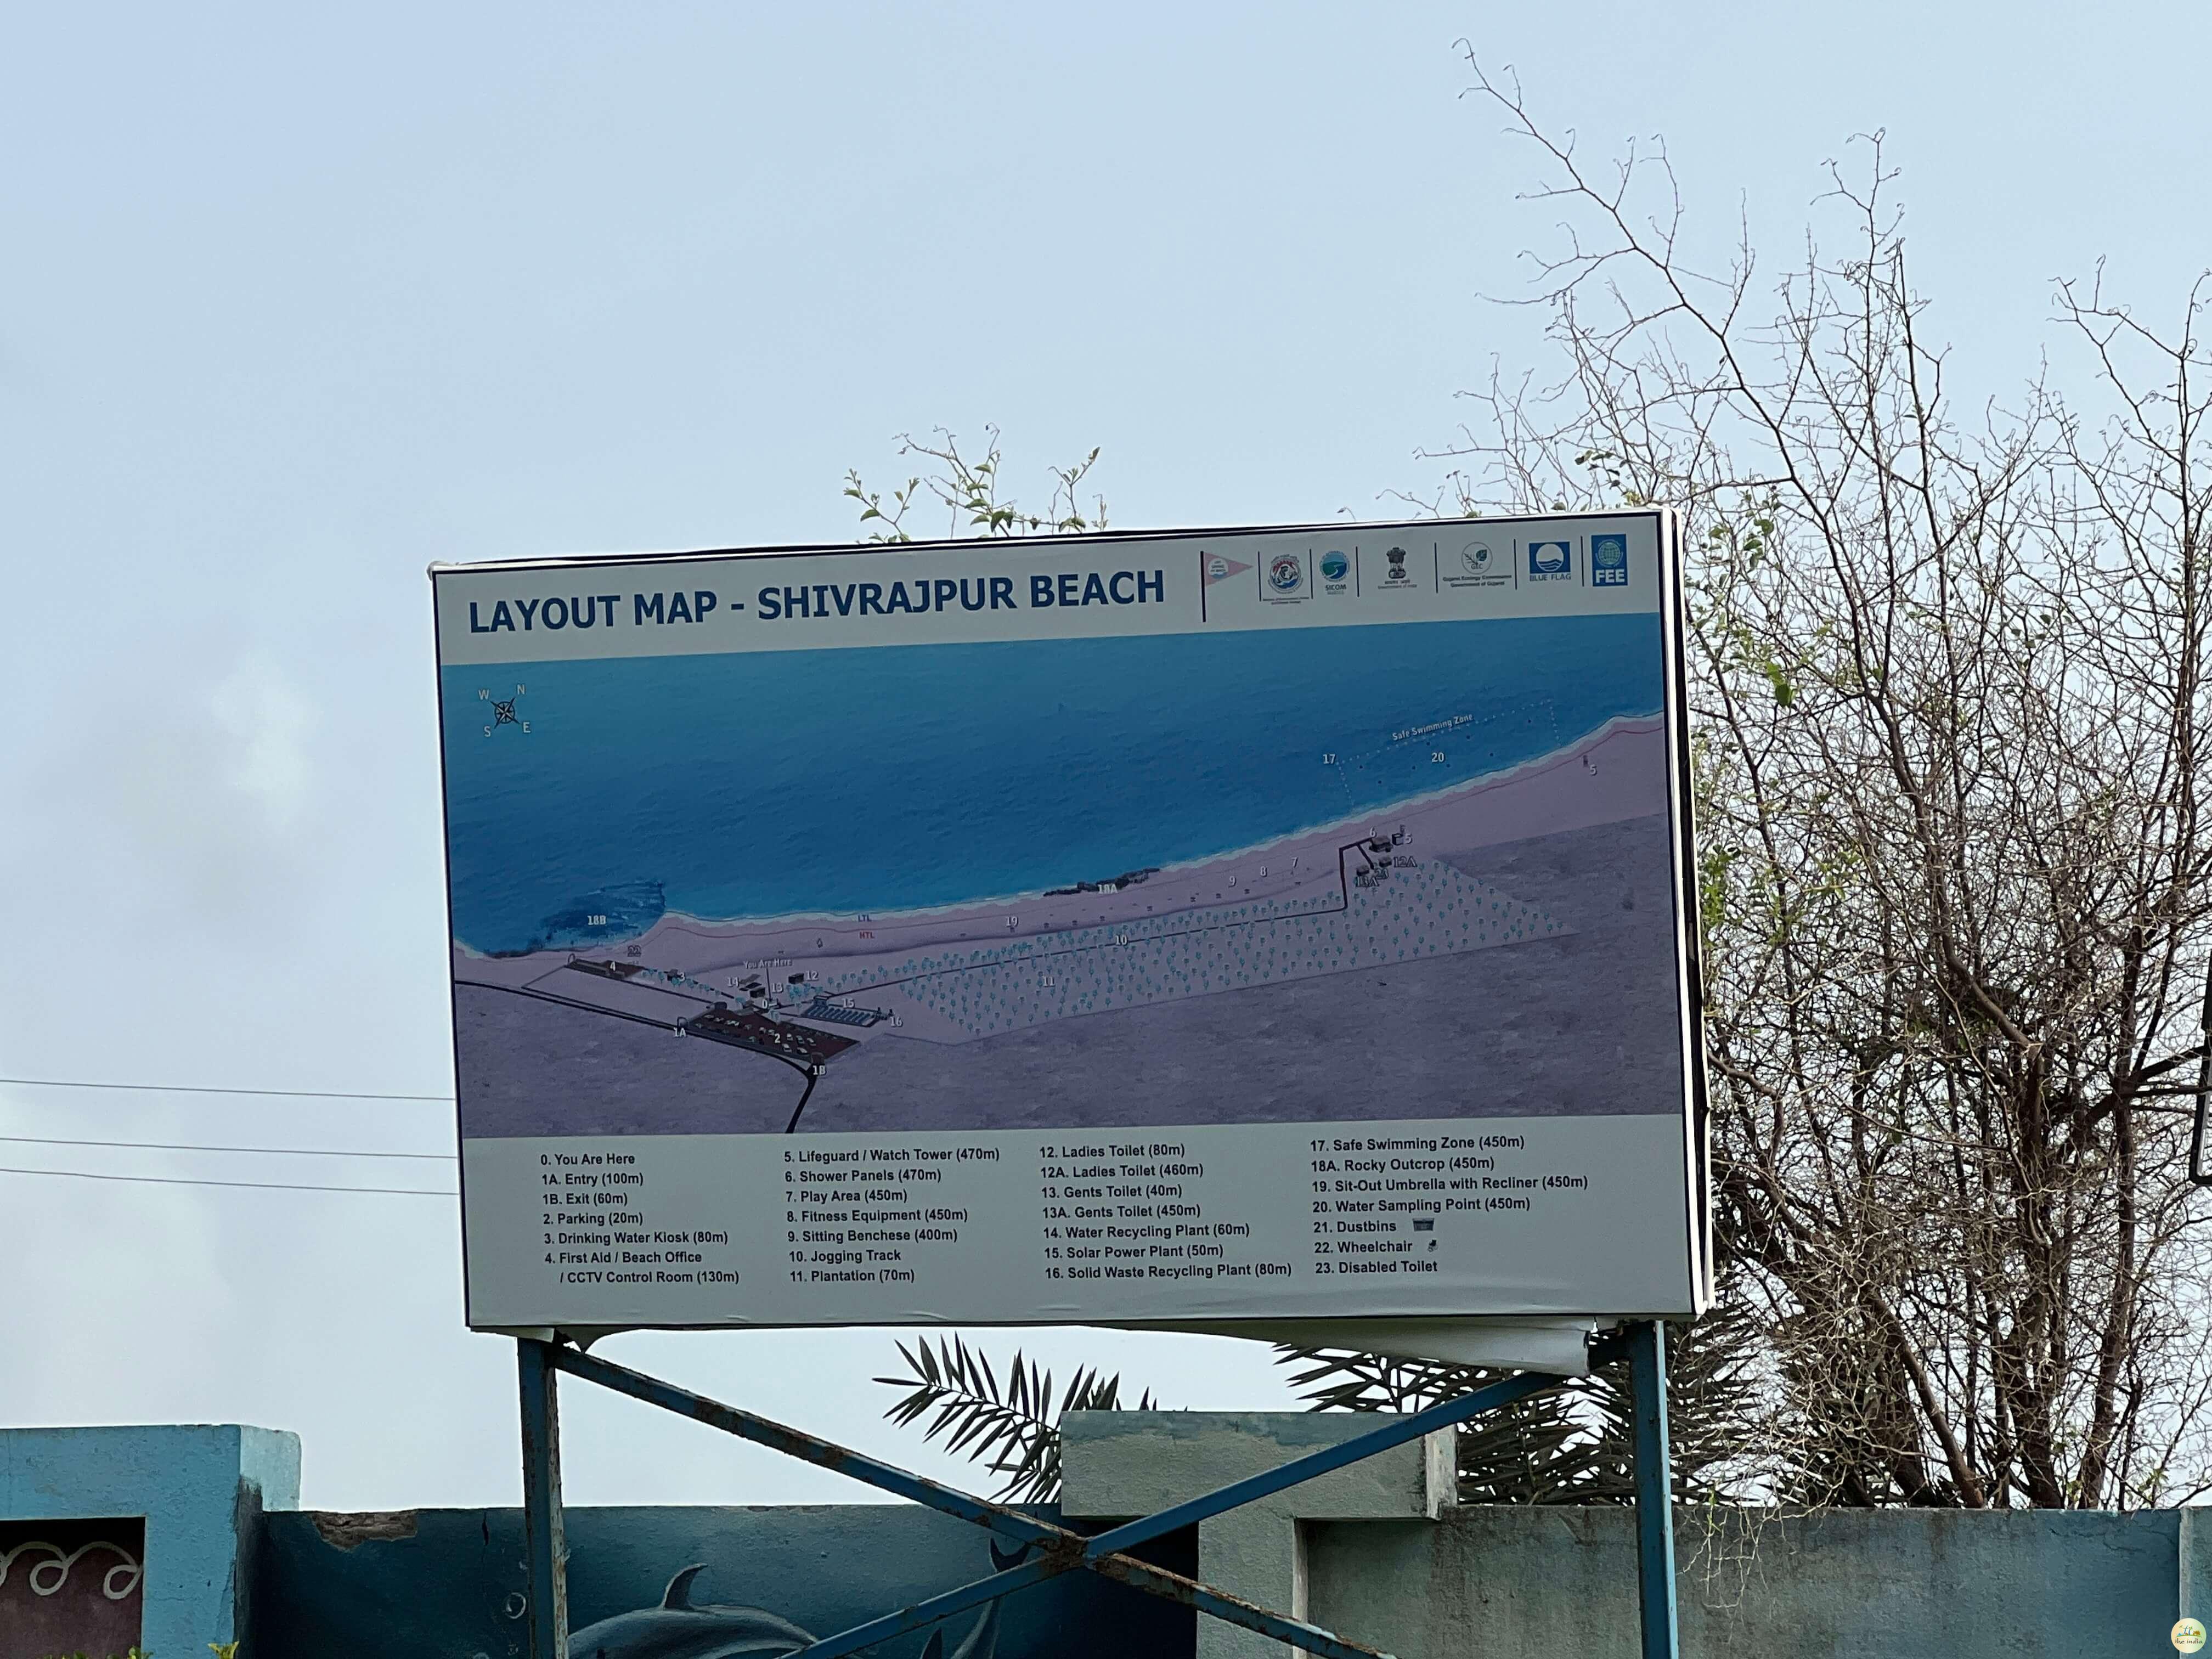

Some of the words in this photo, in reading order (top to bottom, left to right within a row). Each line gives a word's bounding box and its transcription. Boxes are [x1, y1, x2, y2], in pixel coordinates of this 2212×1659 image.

[1595, 569, 1625, 583] FEE
[469, 595, 621, 634] LAYOUT
[634, 590, 718, 625] MAP
[731, 603, 744, 612] -
[757, 577, 1016, 620] SHIVRAJPUR
[1030, 569, 1165, 608] BEACH
[478, 689, 489, 700] W
[517, 684, 525, 695] N
[484, 726, 491, 737] S
[523, 722, 531, 733] E
[1392, 729, 1410, 741] Safe
[1412, 720, 1452, 736] Swimming
[1323, 754, 1336, 764] 17
[1431, 752, 1444, 763] 20
[1589, 765, 1597, 776] 5
[1006, 917, 1019, 927] 19
[1115, 935, 1128, 945] 10
[743, 961, 757, 969] You
[759, 960, 772, 968] Are
[774, 958, 792, 967] Here
[727, 977, 740, 987] 14
[806, 971, 819, 980] 12
[1043, 977, 1055, 986] 11
[771, 984, 783, 992] 13
[843, 998, 855, 1008] 15
[890, 1017, 903, 1026] 16
[673, 1028, 687, 1037] 1A
[812, 1065, 826, 1075] 1B
[1311, 1140, 1329, 1151] 17.
[1334, 1139, 1362, 1150] Safe
[1368, 1138, 1436, 1151] Swimming
[1441, 1137, 1474, 1148] Zone
[1480, 1136, 1524, 1150] (450m)
[785, 1152, 794, 1162] 5.
[799, 1150, 859, 1164] Lifeguard
[863, 1150, 866, 1161] /
[870, 1149, 909, 1160] Watch
[913, 1149, 952, 1160] Tower
[957, 1148, 999, 1162] (470m)
[1040, 1147, 1058, 1158] 12.
[1063, 1146, 1104, 1157] Ladies
[1109, 1145, 1144, 1156] Toilet
[1149, 1144, 1184, 1158] (80m)
[541, 1154, 551, 1165] 0.
[555, 1154, 577, 1165] You
[582, 1154, 602, 1164] Are
[607, 1154, 635, 1164] Here
[1312, 1160, 1340, 1172] 18A.
[1345, 1159, 1386, 1173] Rocky
[1391, 1159, 1444, 1172] Outcrop
[1449, 1156, 1494, 1172] (450m)
[786, 1171, 795, 1182] 6.
[800, 1171, 847, 1182] Shower
[852, 1170, 894, 1181] Panels
[899, 1169, 941, 1183] (470m)
[1041, 1167, 1068, 1178] 12A.
[1074, 1166, 1115, 1177] Ladies
[1120, 1165, 1155, 1176] Toilet
[1160, 1164, 1203, 1178] (460m)
[543, 1174, 561, 1184] 1A.
[566, 1173, 597, 1187] Entry
[602, 1173, 643, 1187] (100m)
[1312, 1181, 1330, 1192] 19.
[1335, 1180, 1381, 1192] Sit-Out
[1386, 1178, 1445, 1190] Umbrella
[1450, 1177, 1477, 1189] with
[1483, 1177, 1538, 1188] Recliner
[1543, 1176, 1587, 1190] (450m)
[786, 1192, 796, 1202] 7.
[801, 1191, 827, 1204] Play
[832, 1190, 860, 1201] Area
[865, 1189, 907, 1203] (450m)
[1042, 1187, 1059, 1198] 13.
[1064, 1187, 1102, 1198] Gents
[1106, 1186, 1142, 1197] Toilet
[1147, 1184, 1182, 1199] (40m)
[543, 1194, 562, 1204] 1B.
[567, 1193, 589, 1204] Exit
[594, 1193, 627, 1206] (60m)
[1313, 1201, 1331, 1212] 20.
[1336, 1201, 1374, 1212] Water
[1379, 1199, 1441, 1213] Sampling
[1446, 1198, 1481, 1210] Point
[1485, 1198, 1530, 1212] (450m)
[787, 1211, 797, 1222] 8.
[802, 1211, 847, 1222] Fitness
[853, 1210, 921, 1223] Equipment
[926, 1209, 967, 1222] (450m)
[1043, 1207, 1070, 1218] 13A.
[1075, 1207, 1113, 1217] Gents
[1117, 1205, 1152, 1217] Toilet
[1157, 1204, 1200, 1219] (450m)
[544, 1214, 553, 1224] 2.
[558, 1213, 604, 1226] Parking
[609, 1212, 642, 1226] (20m)
[1044, 1227, 1061, 1238] 14.
[1066, 1227, 1103, 1238] Water
[1108, 1226, 1171, 1240] Recycling
[1176, 1224, 1209, 1235] Plant
[1214, 1223, 1249, 1238] (60m)
[1314, 1222, 1332, 1233] 21.
[1338, 1221, 1396, 1232] Dustbins
[545, 1233, 554, 1244] 3.
[559, 1233, 610, 1246] Drinking
[614, 1232, 650, 1243] Water
[654, 1232, 689, 1243] Kiosk
[693, 1231, 727, 1245] (80m)
[788, 1231, 798, 1242] 9.
[803, 1231, 843, 1244] Sitting
[848, 1229, 910, 1240] Benchese
[915, 1229, 957, 1243] (400m)
[1045, 1248, 1062, 1258] 15.
[1067, 1247, 1101, 1258] Solar
[1105, 1246, 1146, 1257] Power
[1150, 1246, 1183, 1256] Plant
[1187, 1244, 1223, 1259] (50m)
[1315, 1242, 1333, 1253] 22.
[1338, 1240, 1412, 1252] Wheelchair
[545, 1253, 555, 1263] 4.
[560, 1252, 587, 1263] First
[591, 1252, 611, 1263] Aid
[615, 1252, 618, 1263] /
[623, 1252, 661, 1262] Beach
[665, 1251, 701, 1262] Office
[789, 1251, 806, 1262] 10.
[811, 1250, 862, 1264] Jogging
[866, 1249, 901, 1261] Track
[1046, 1268, 1063, 1278] 16.
[1068, 1267, 1100, 1278] Solid
[1105, 1267, 1144, 1277] Waste
[1149, 1265, 1212, 1279] Recycling
[1218, 1265, 1251, 1275] Plant
[1255, 1263, 1291, 1278] (80m)
[1316, 1262, 1334, 1273] 23.
[1339, 1261, 1396, 1273] Disabled
[1401, 1261, 1437, 1272] Toilet
[560, 1272, 563, 1283] /
[568, 1272, 602, 1283] CCTV
[607, 1272, 652, 1282] Control
[657, 1272, 692, 1282] Room
[697, 1271, 738, 1284] (130m)
[791, 1271, 806, 1282] 11.
[812, 1270, 874, 1282] Plantation
[880, 1269, 914, 1283] (70m)
